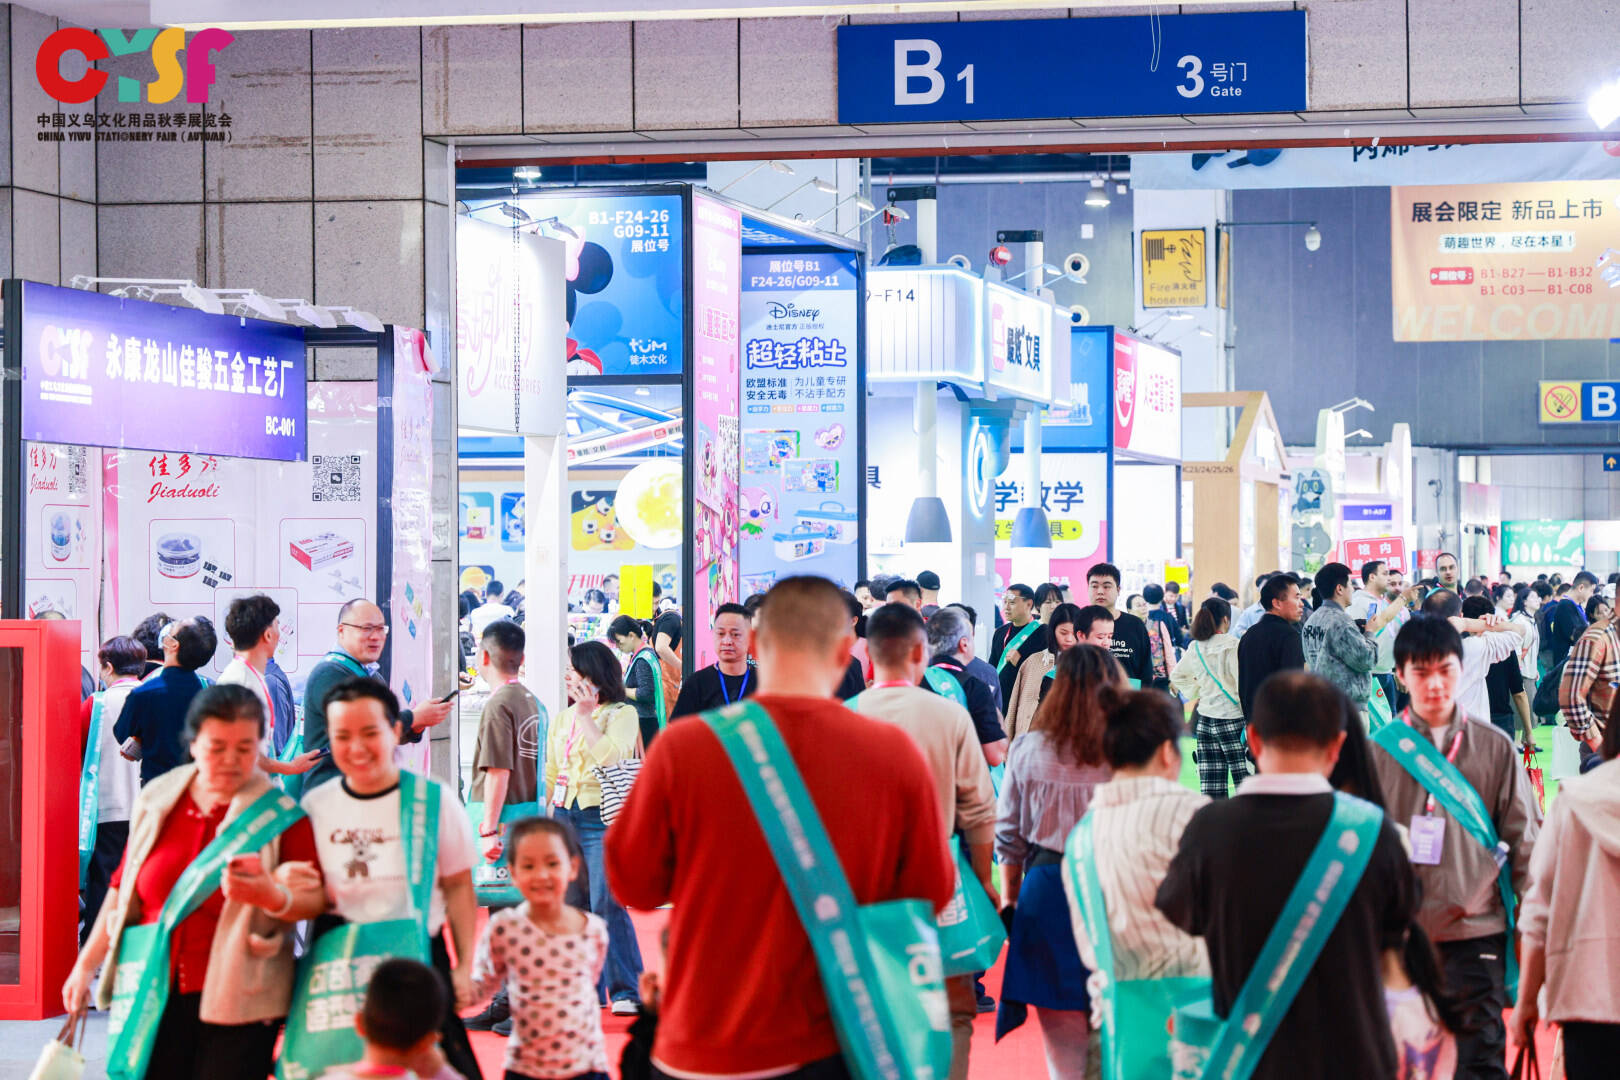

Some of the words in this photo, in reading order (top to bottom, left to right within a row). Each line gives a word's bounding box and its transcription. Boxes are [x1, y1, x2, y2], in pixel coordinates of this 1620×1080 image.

[1210, 62, 1247, 82] 号门
[1210, 86, 1242, 97] Gate
[588, 209, 669, 224] B1-F24-26
[1411, 201, 1502, 223] 展会限定
[1512, 198, 1603, 220] 新品上市
[614, 223, 669, 238] G09-11
[631, 239, 669, 252] 展位号
[751, 275, 839, 288] F24-26/G09-11
[747, 337, 847, 370] 超轻粘土
[106, 332, 294, 399] 永康龙山佳骏五金工艺厂
[746, 377, 787, 388] 欧盟标准
[746, 390, 787, 400] 安全无毒
[1592, 385, 1617, 418] B
[265, 415, 295, 437] BC-001
[147, 481, 220, 504] Jiaduoli
